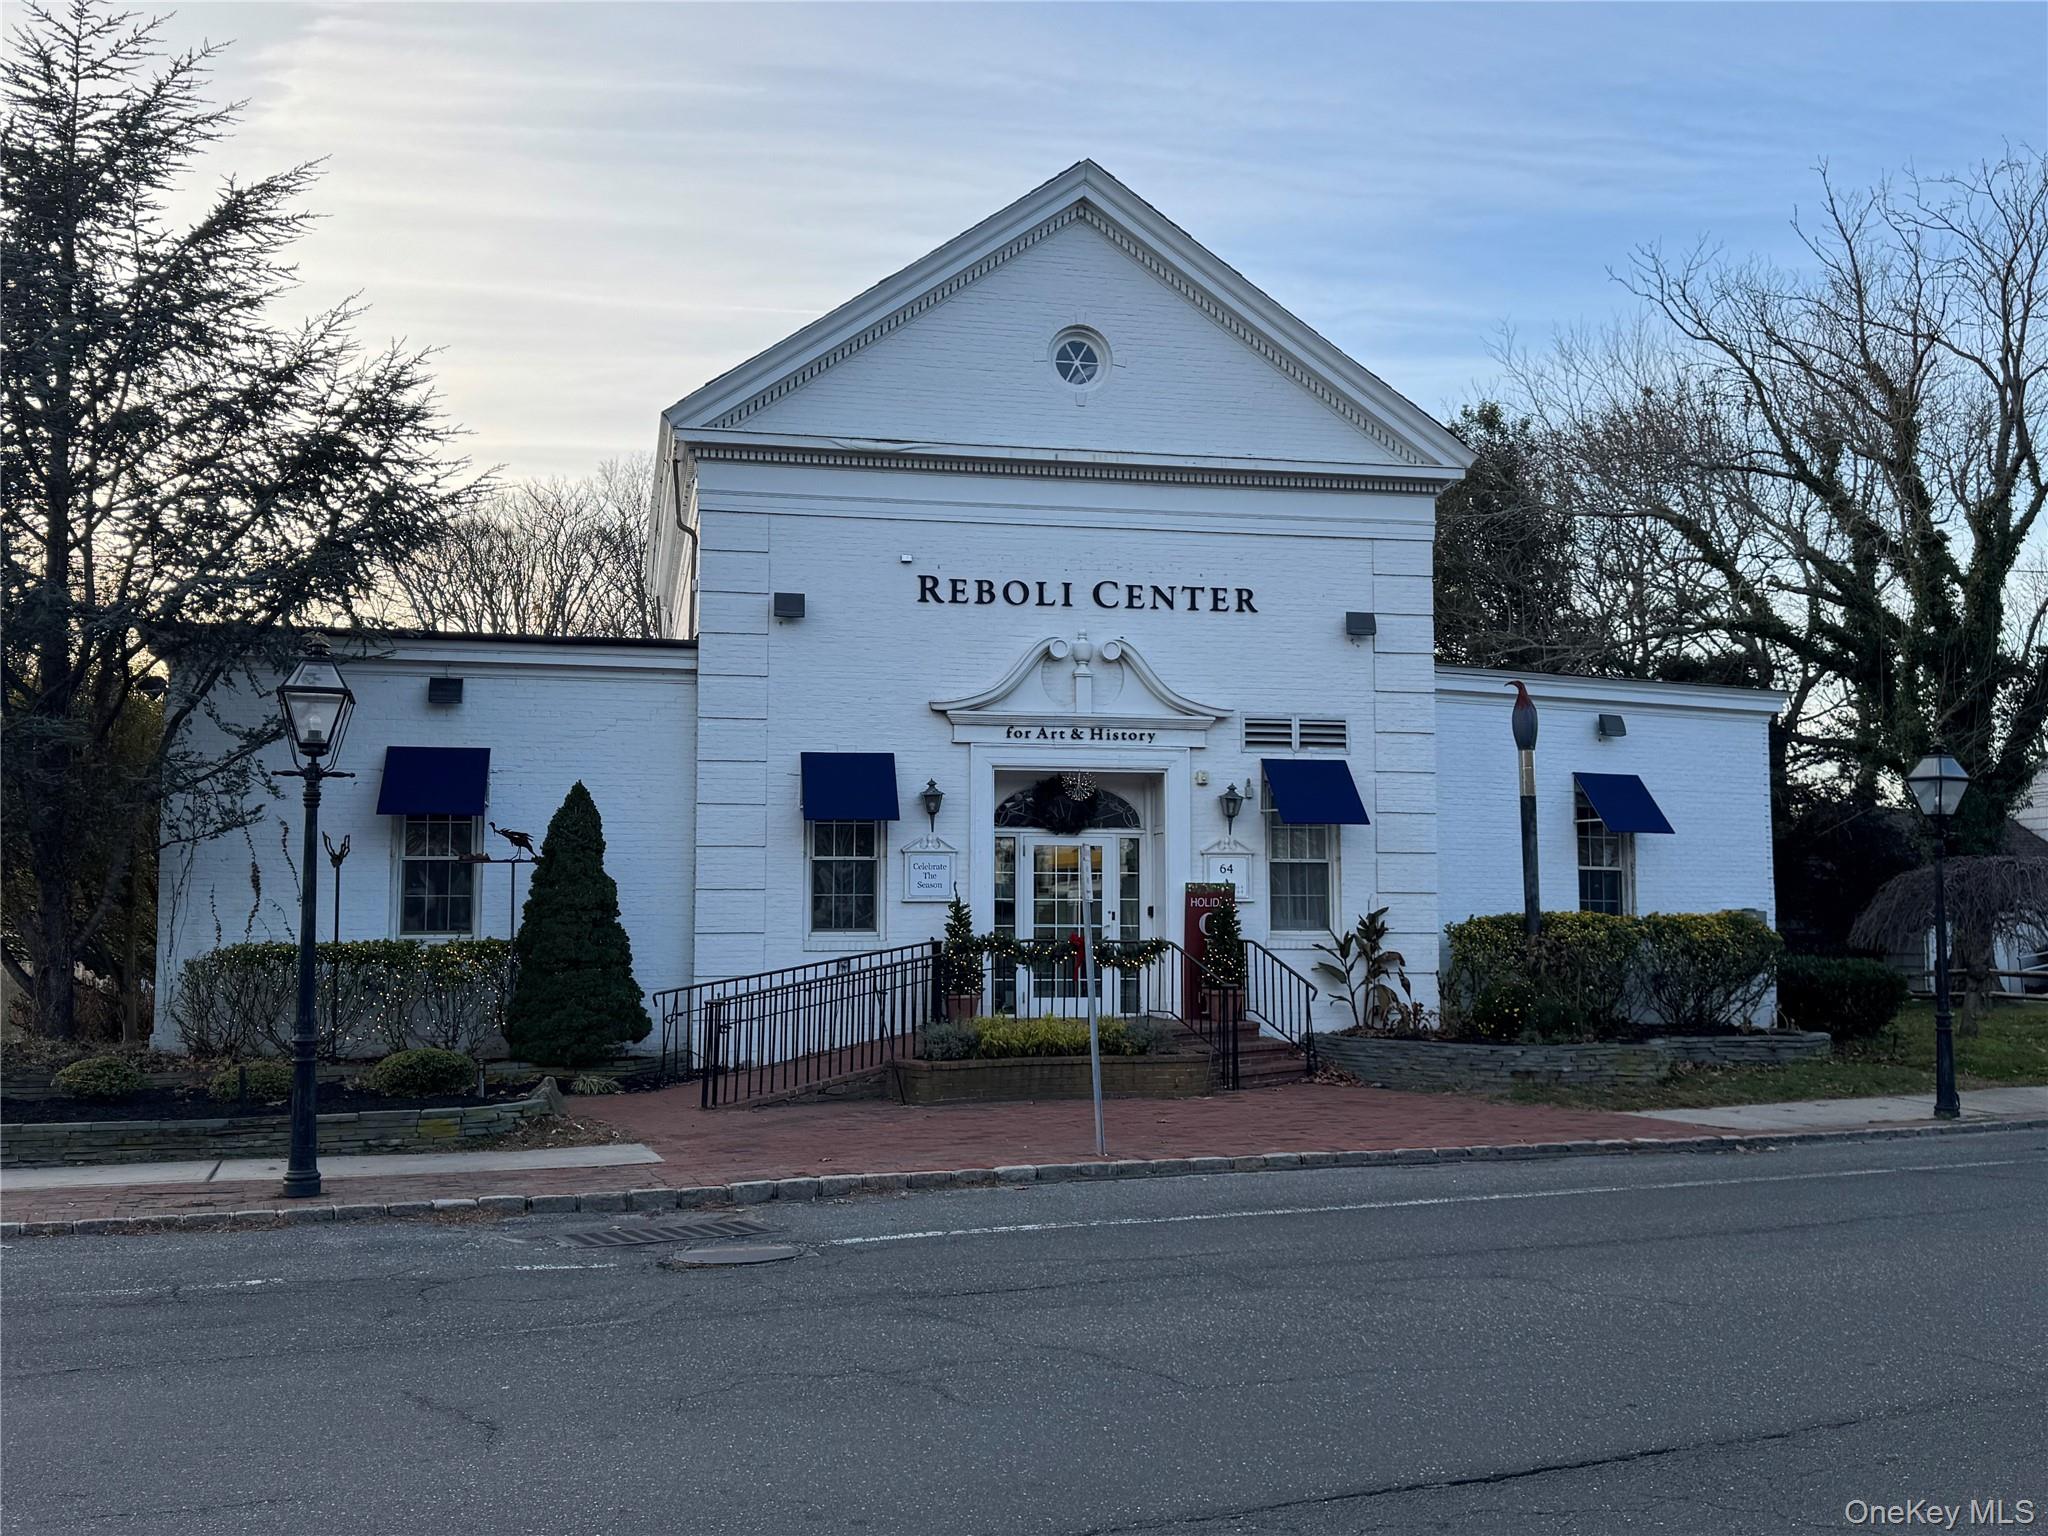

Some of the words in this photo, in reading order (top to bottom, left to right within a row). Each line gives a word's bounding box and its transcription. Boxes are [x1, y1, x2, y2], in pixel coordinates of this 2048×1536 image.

[916, 573, 1073, 608] REBOLI
[1092, 580, 1259, 613] CENTER
[1005, 725, 1031, 739] for
[1036, 726, 1066, 740] Art
[1070, 727, 1084, 740] &
[1090, 727, 1156, 743] History
[913, 862, 947, 871] Celebrate
[1219, 863, 1234, 874] 64
[917, 881, 943, 889] Season
